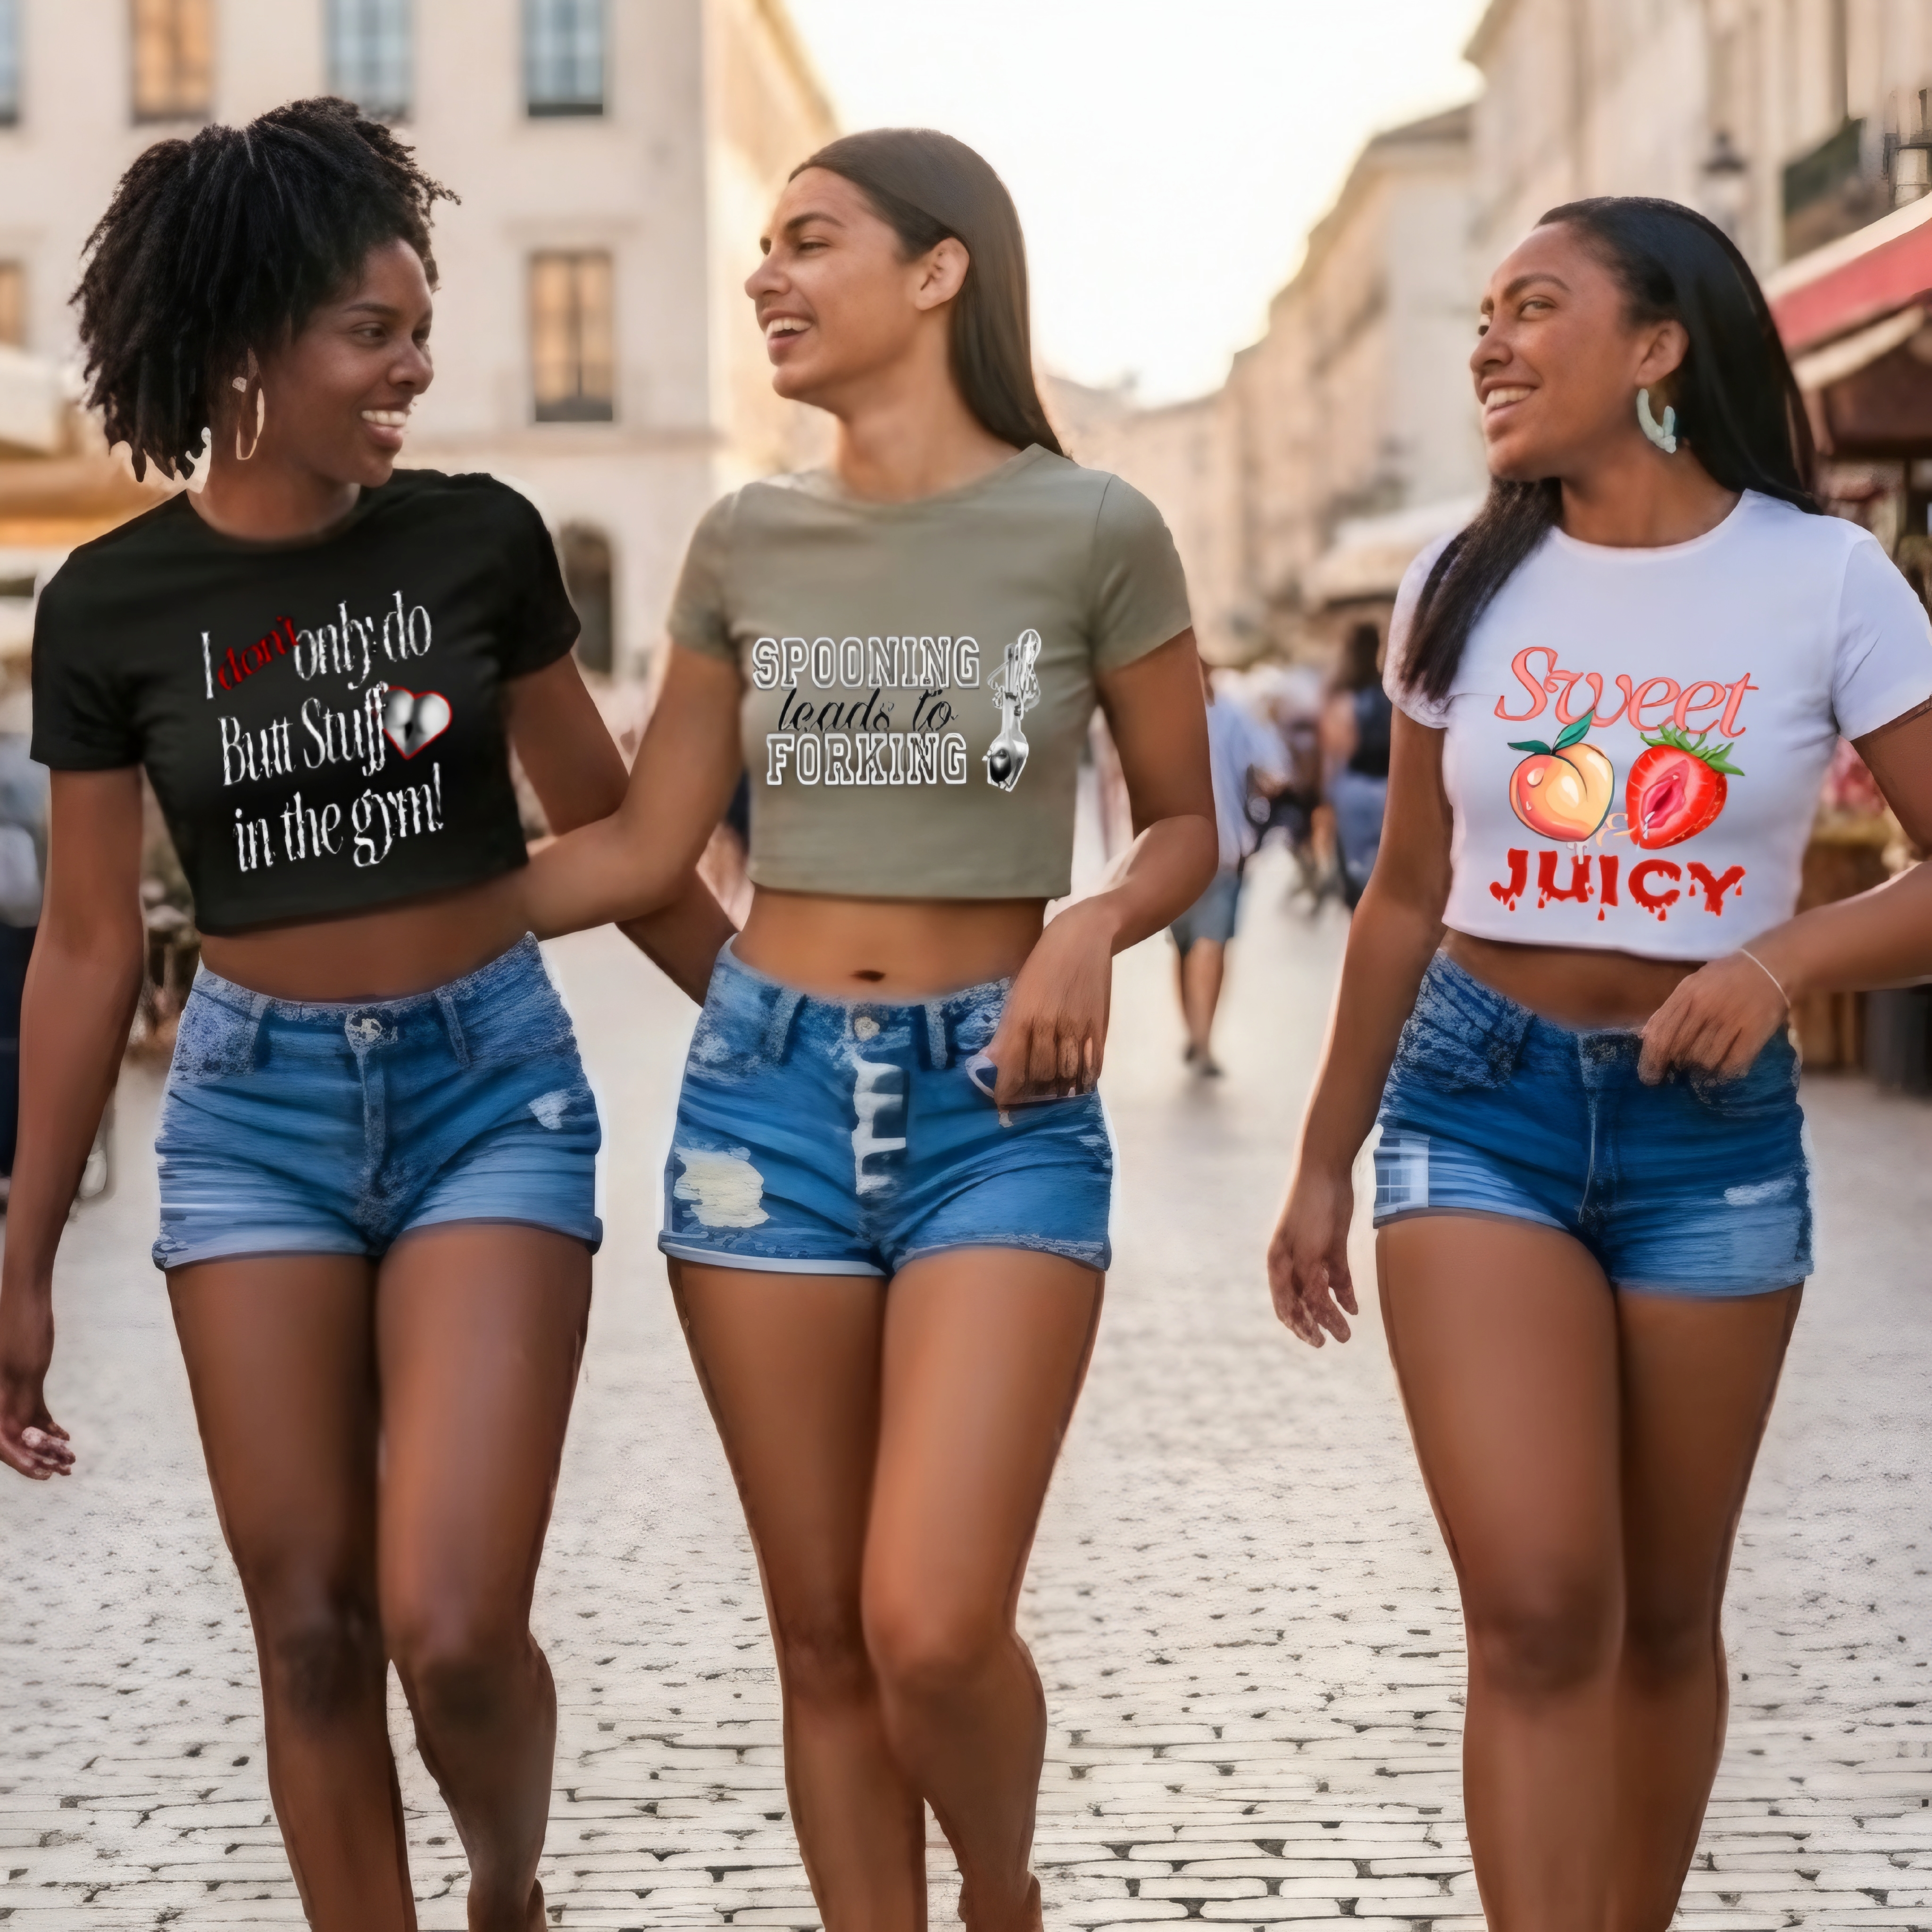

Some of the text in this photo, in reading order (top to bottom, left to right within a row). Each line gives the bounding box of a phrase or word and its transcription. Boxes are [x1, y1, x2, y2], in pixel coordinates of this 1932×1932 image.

[201, 631, 215, 699] I
[294, 600, 375, 690] only
[383, 590, 432, 661] do
[752, 636, 980, 690] SPOONING
[778, 687, 958, 732] leads to
[1494, 646, 1759, 738] Sweet
[218, 681, 388, 786] Butt Stuff
[766, 733, 967, 785] FORKING
[233, 762, 444, 872] in the gym!
[1490, 848, 1746, 921] JUICY
